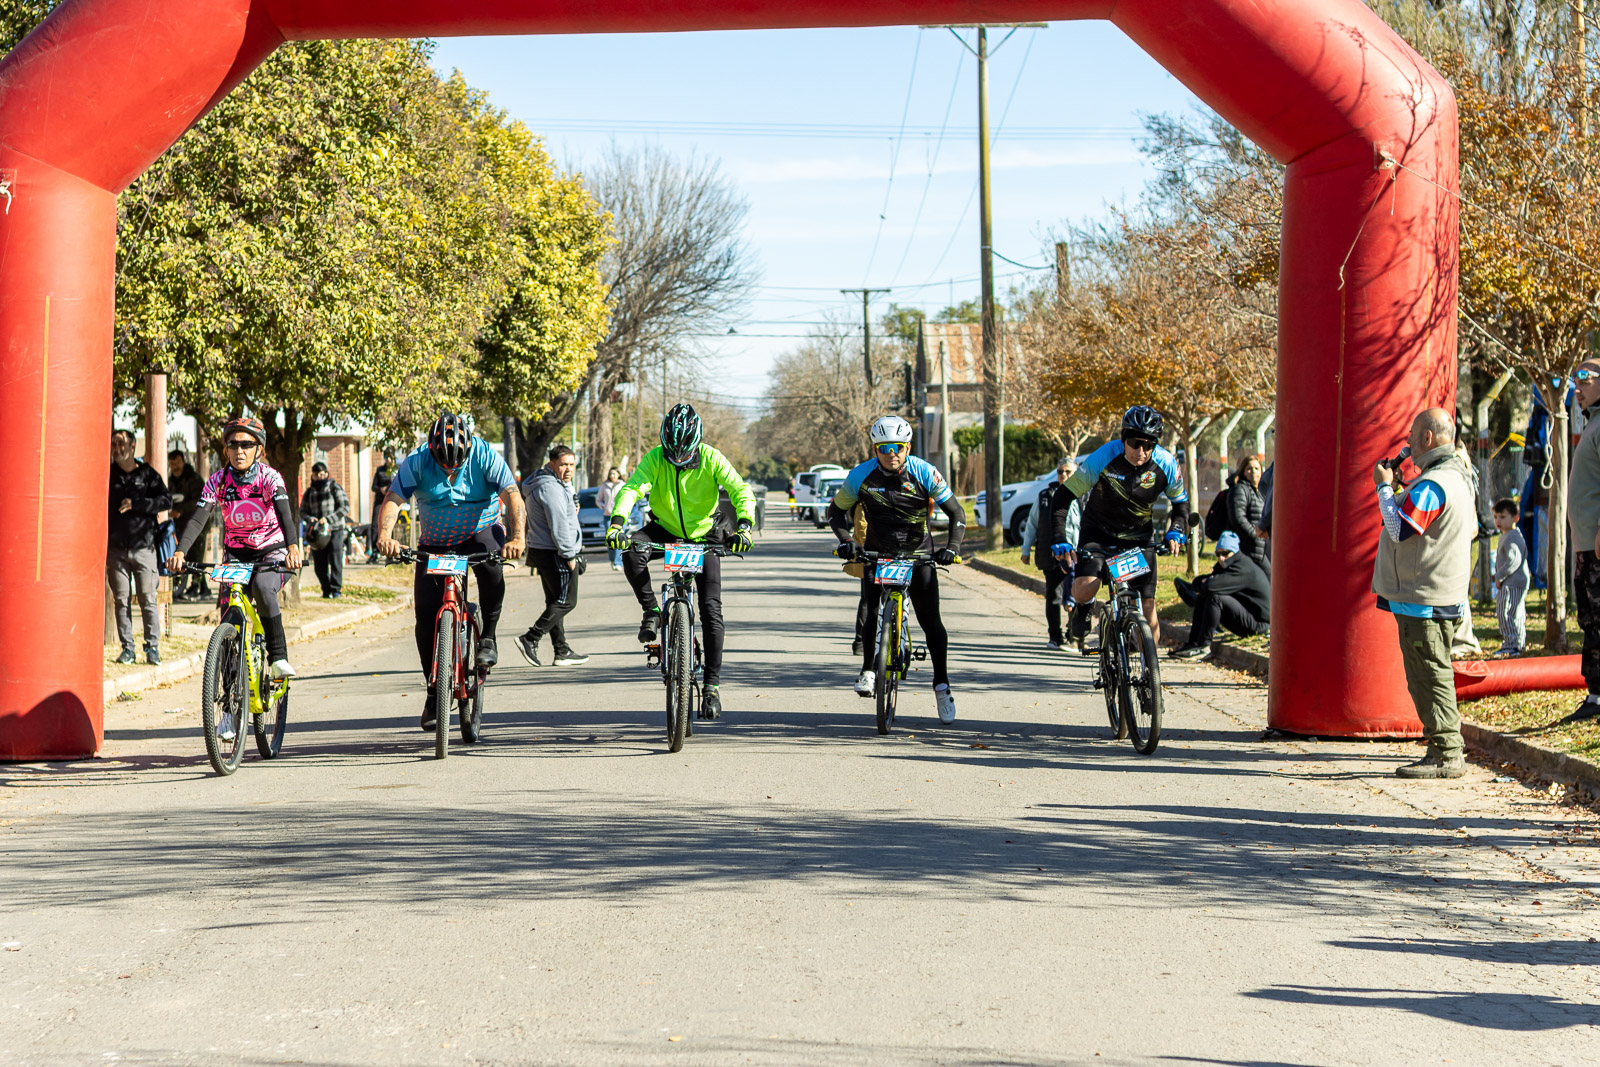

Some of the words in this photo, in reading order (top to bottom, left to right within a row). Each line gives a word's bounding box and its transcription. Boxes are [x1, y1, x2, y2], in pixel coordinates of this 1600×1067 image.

[436, 560, 457, 570] 10
[669, 551, 701, 566] 170
[1117, 555, 1139, 576] 62
